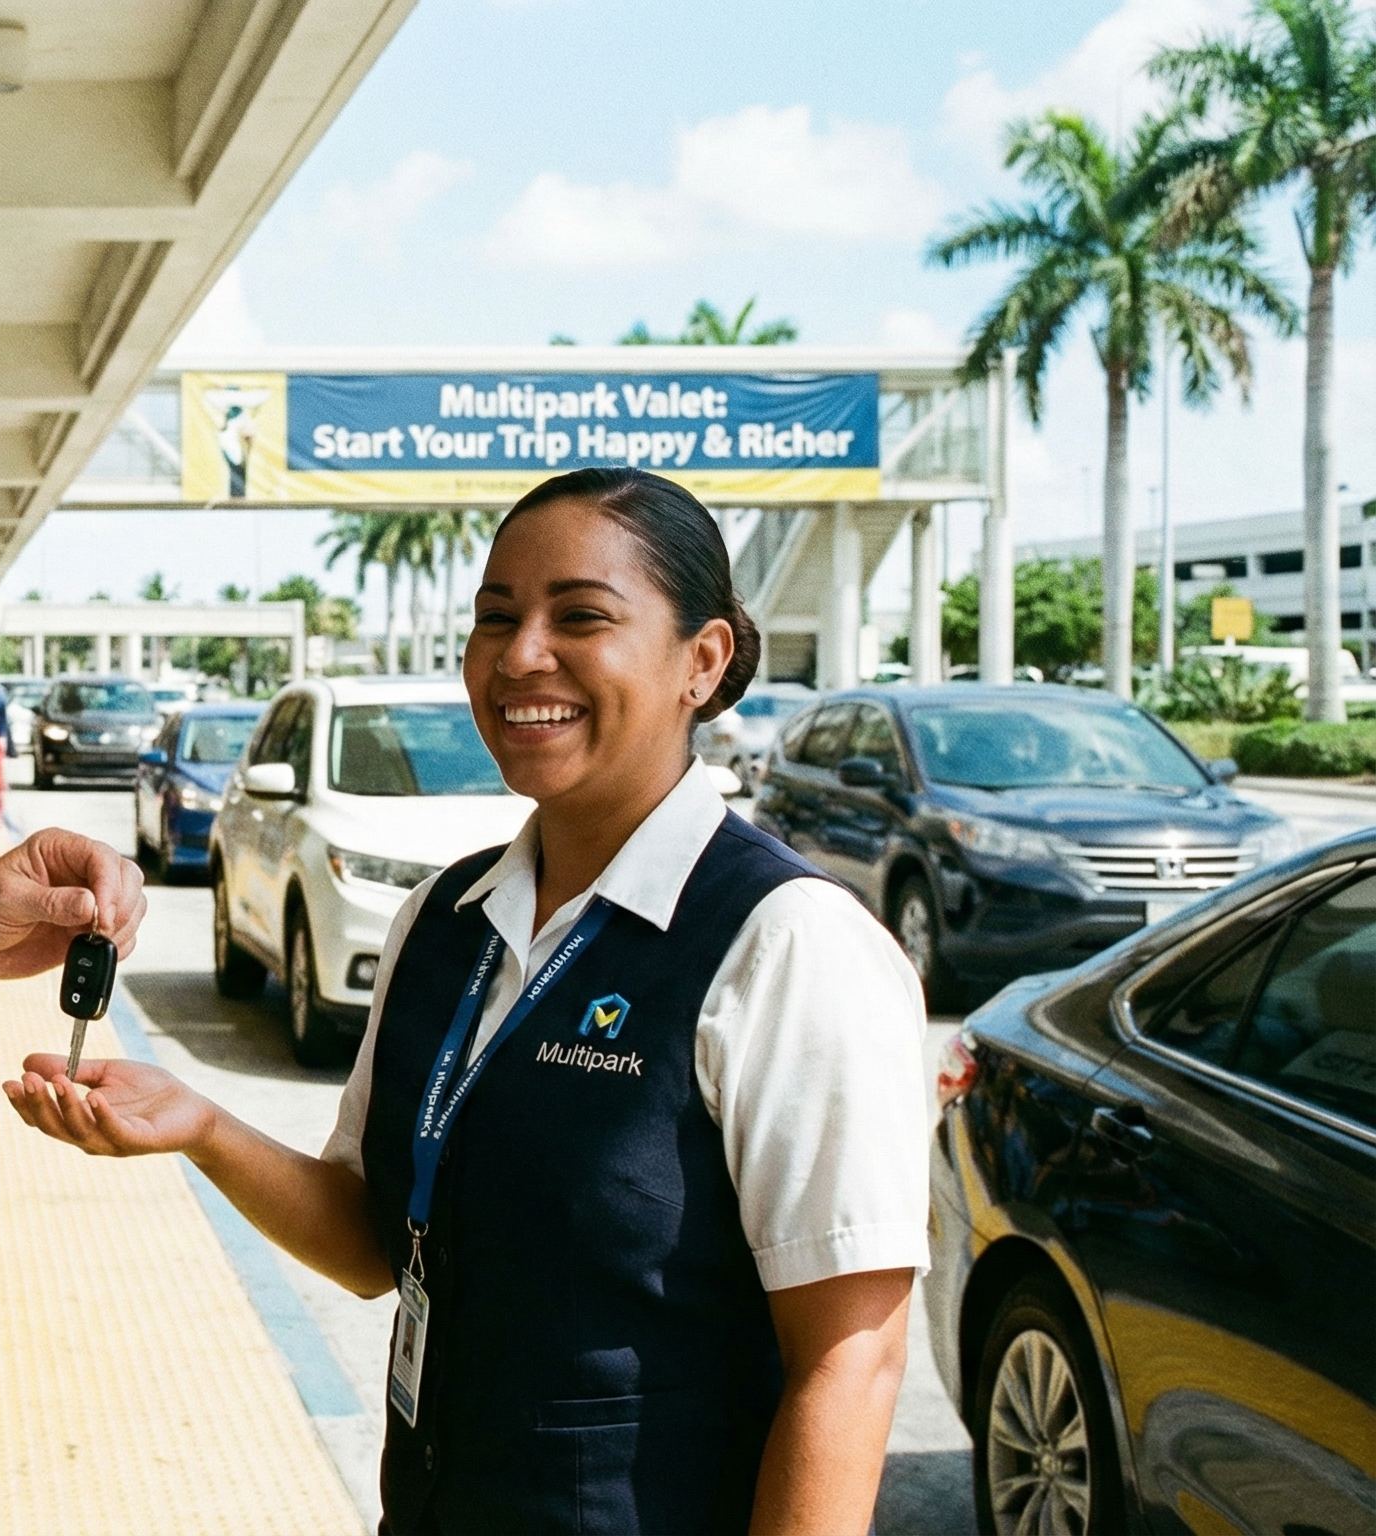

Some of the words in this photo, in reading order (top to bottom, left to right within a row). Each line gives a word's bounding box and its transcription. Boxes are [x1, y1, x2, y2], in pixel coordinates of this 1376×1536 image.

[439, 383, 618, 425] Multipark
[624, 382, 728, 418] Valet:
[313, 425, 403, 459] Start
[408, 425, 494, 459] Your
[498, 425, 571, 466] Trip
[578, 425, 697, 466] Happy
[702, 425, 733, 458] &
[738, 424, 854, 459] Richer
[536, 1041, 644, 1077] Multipark
